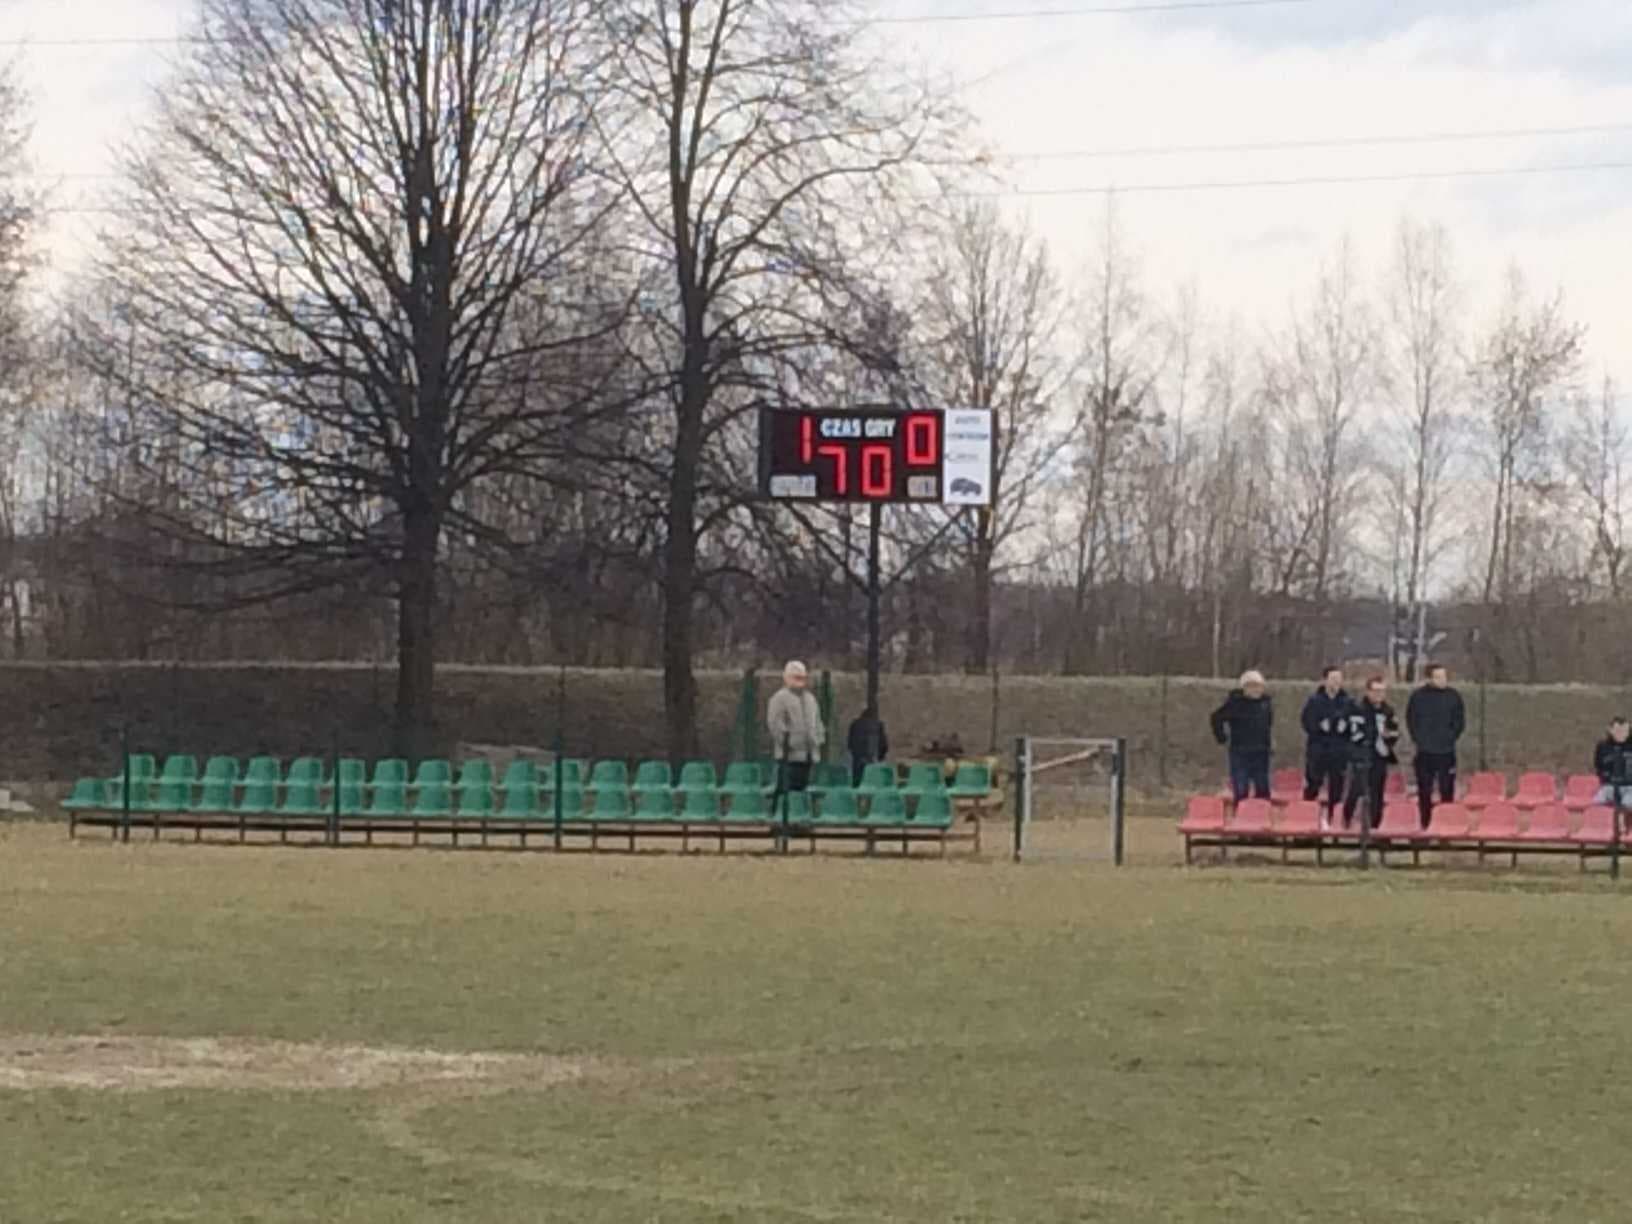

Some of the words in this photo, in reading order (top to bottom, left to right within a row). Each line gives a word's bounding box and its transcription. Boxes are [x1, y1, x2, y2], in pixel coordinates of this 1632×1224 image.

[802, 416, 812, 464] 1
[821, 418, 861, 437] CZAS
[907, 415, 937, 465] 0
[818, 445, 892, 496] 70
